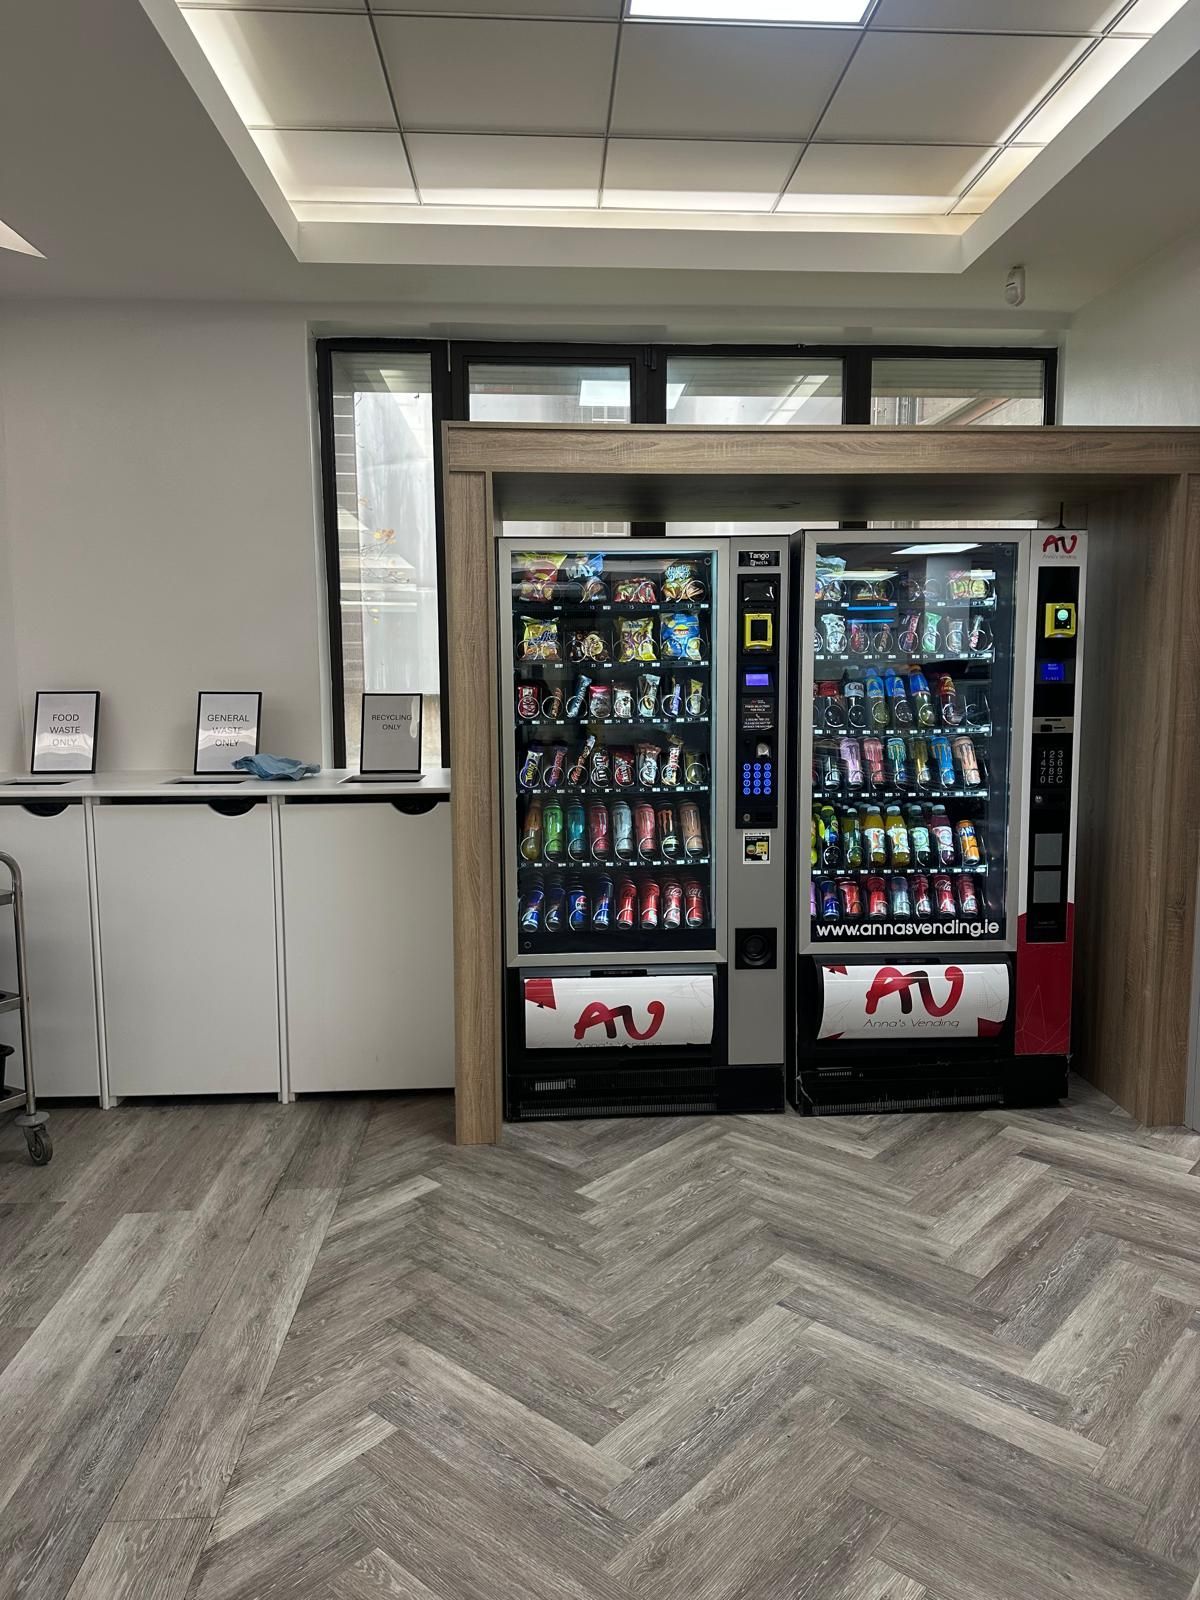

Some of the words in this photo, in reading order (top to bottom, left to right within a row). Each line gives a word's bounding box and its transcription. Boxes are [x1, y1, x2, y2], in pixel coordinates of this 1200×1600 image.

[749, 552, 770, 560] Tango
[208, 714, 250, 722] GENERAL
[216, 739, 239, 747] ONLY
[1050, 750, 1056, 758] 2
[1057, 750, 1064, 758] 3
[1040, 767, 1046, 775] 7
[1049, 767, 1055, 775] 8
[1057, 767, 1063, 775] 9
[1056, 776, 1063, 784] C
[816, 919, 999, 937] www.annasvending.ie
[865, 966, 964, 1017] AV
[574, 1001, 665, 1040] AV
[864, 1018, 906, 1028] Anna's
[911, 1018, 960, 1028] Vending
